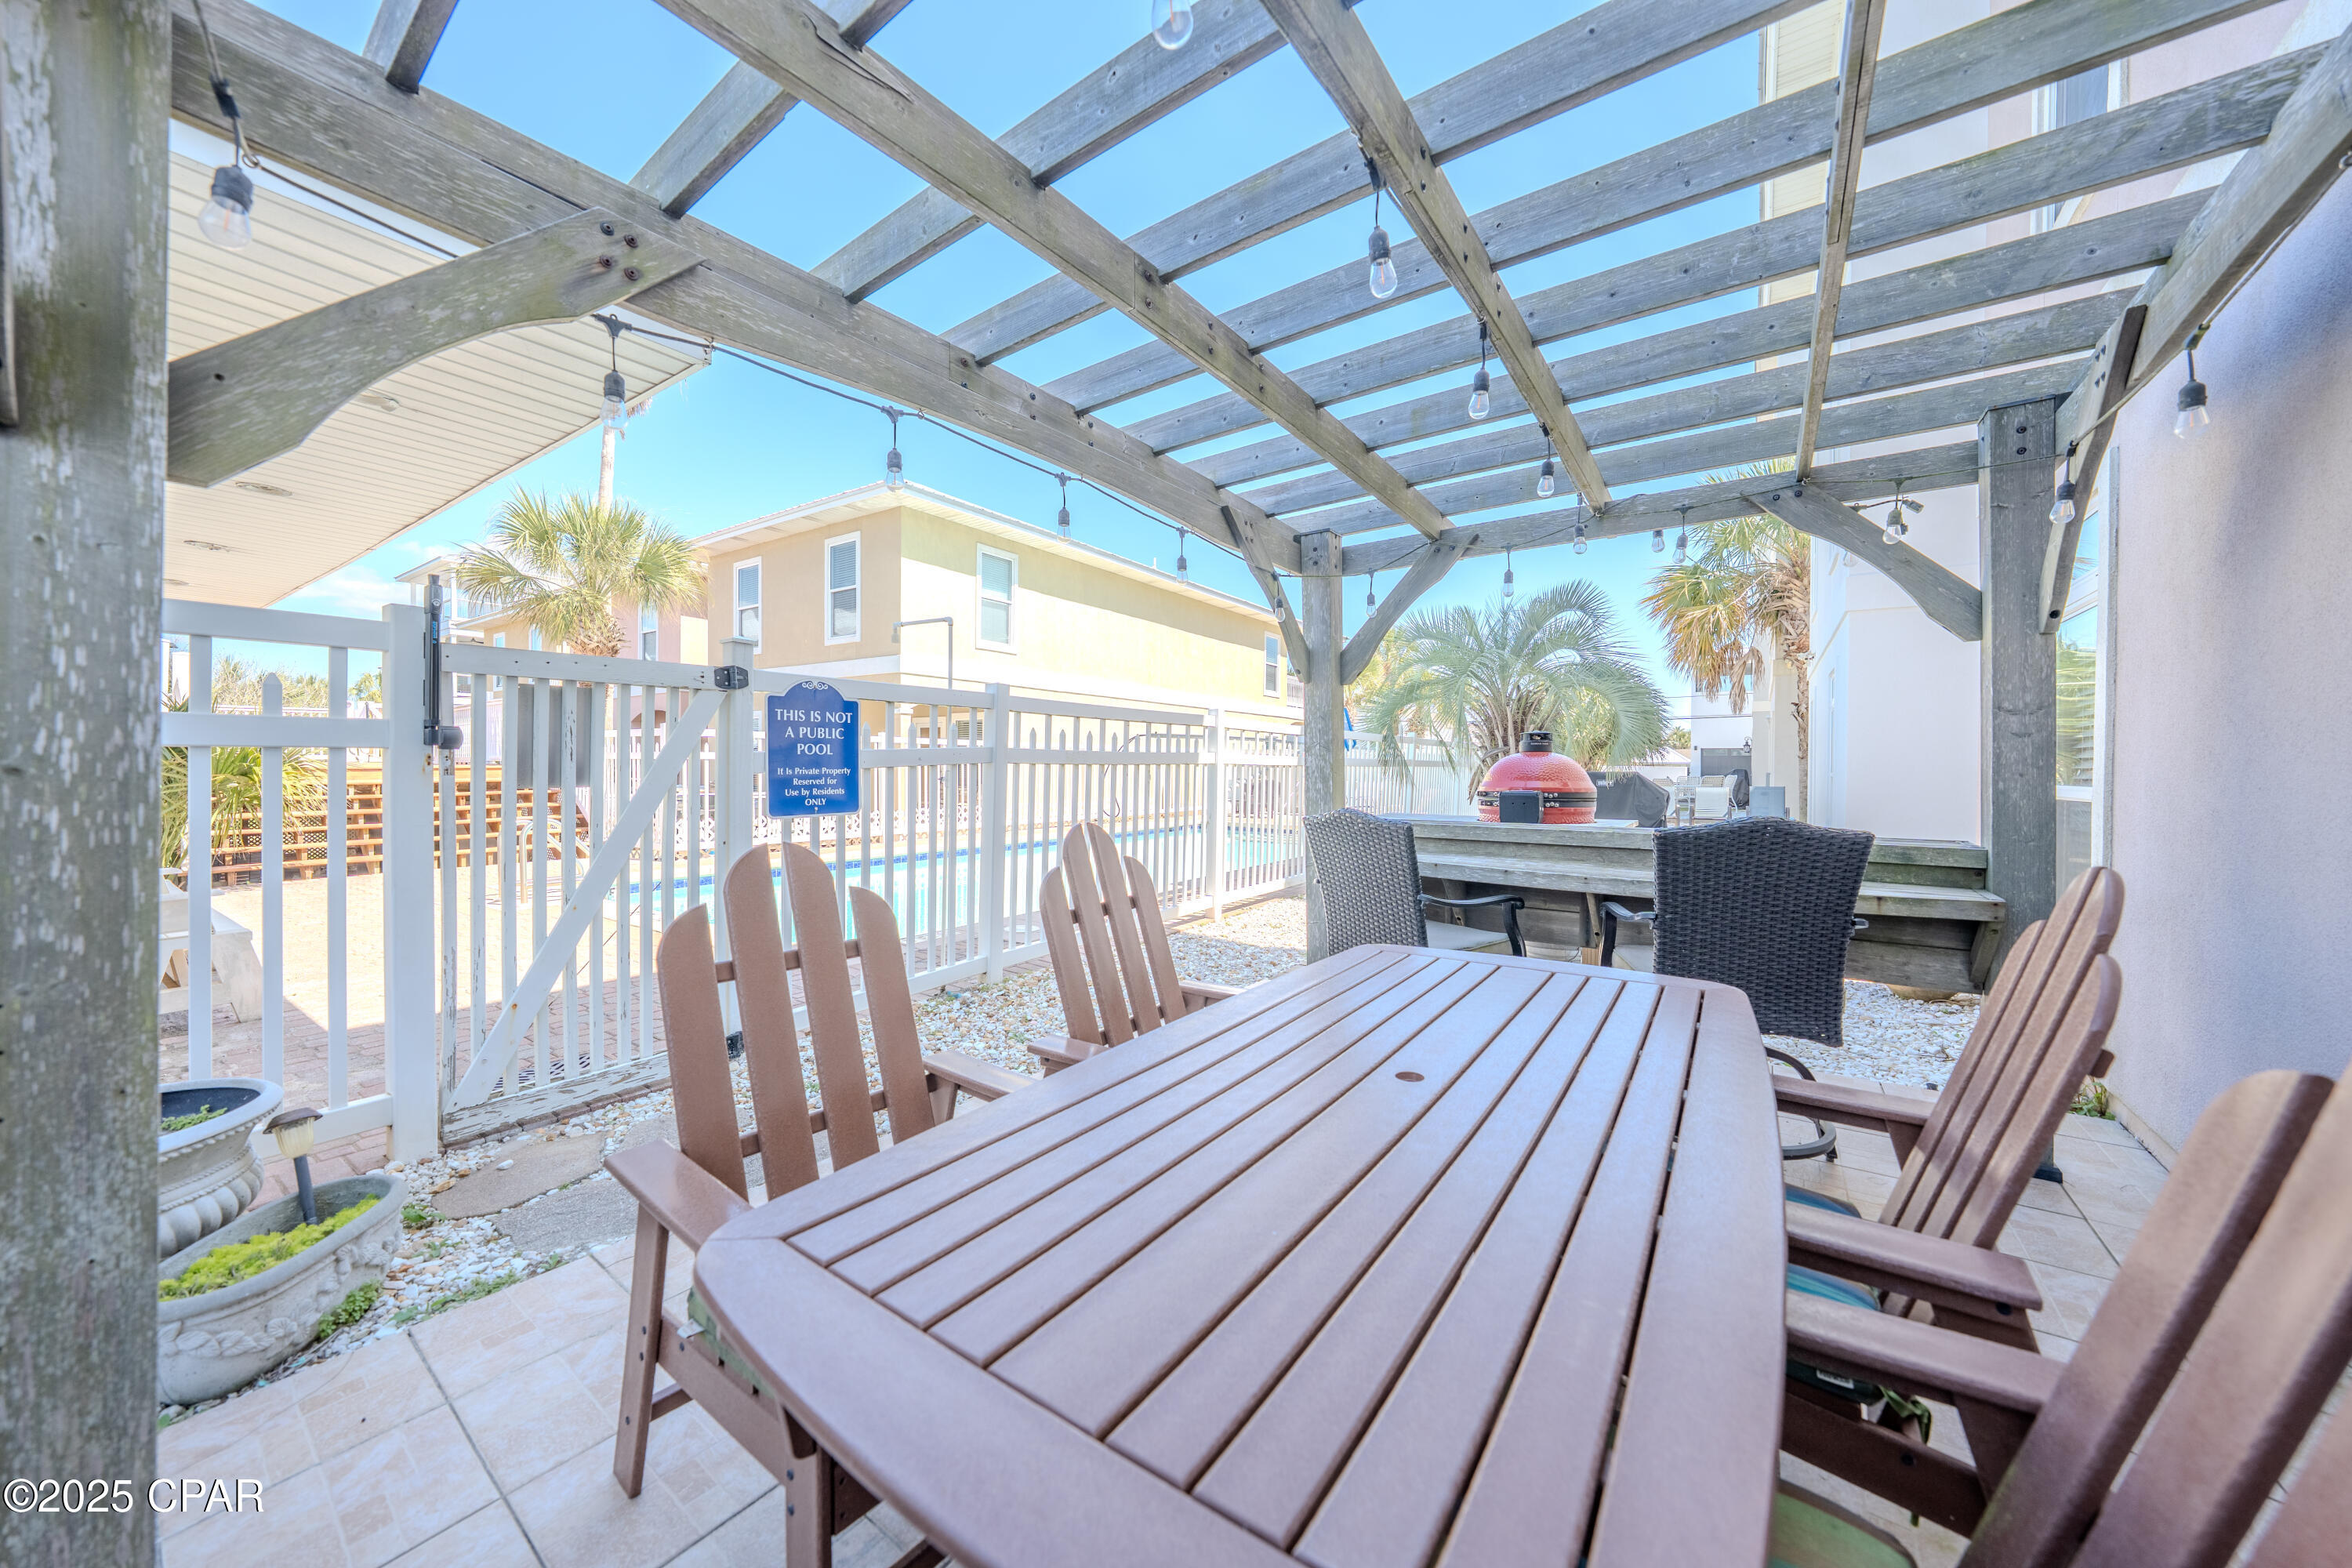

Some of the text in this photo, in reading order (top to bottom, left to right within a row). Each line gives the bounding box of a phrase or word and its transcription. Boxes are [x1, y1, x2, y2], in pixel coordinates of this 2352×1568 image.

[775, 709, 852, 723] THIS IS NOT
[785, 727, 844, 739] A PUBLIC
[797, 743, 833, 755] POOL
[822, 768, 851, 776] Property
[802, 788, 810, 797] by
